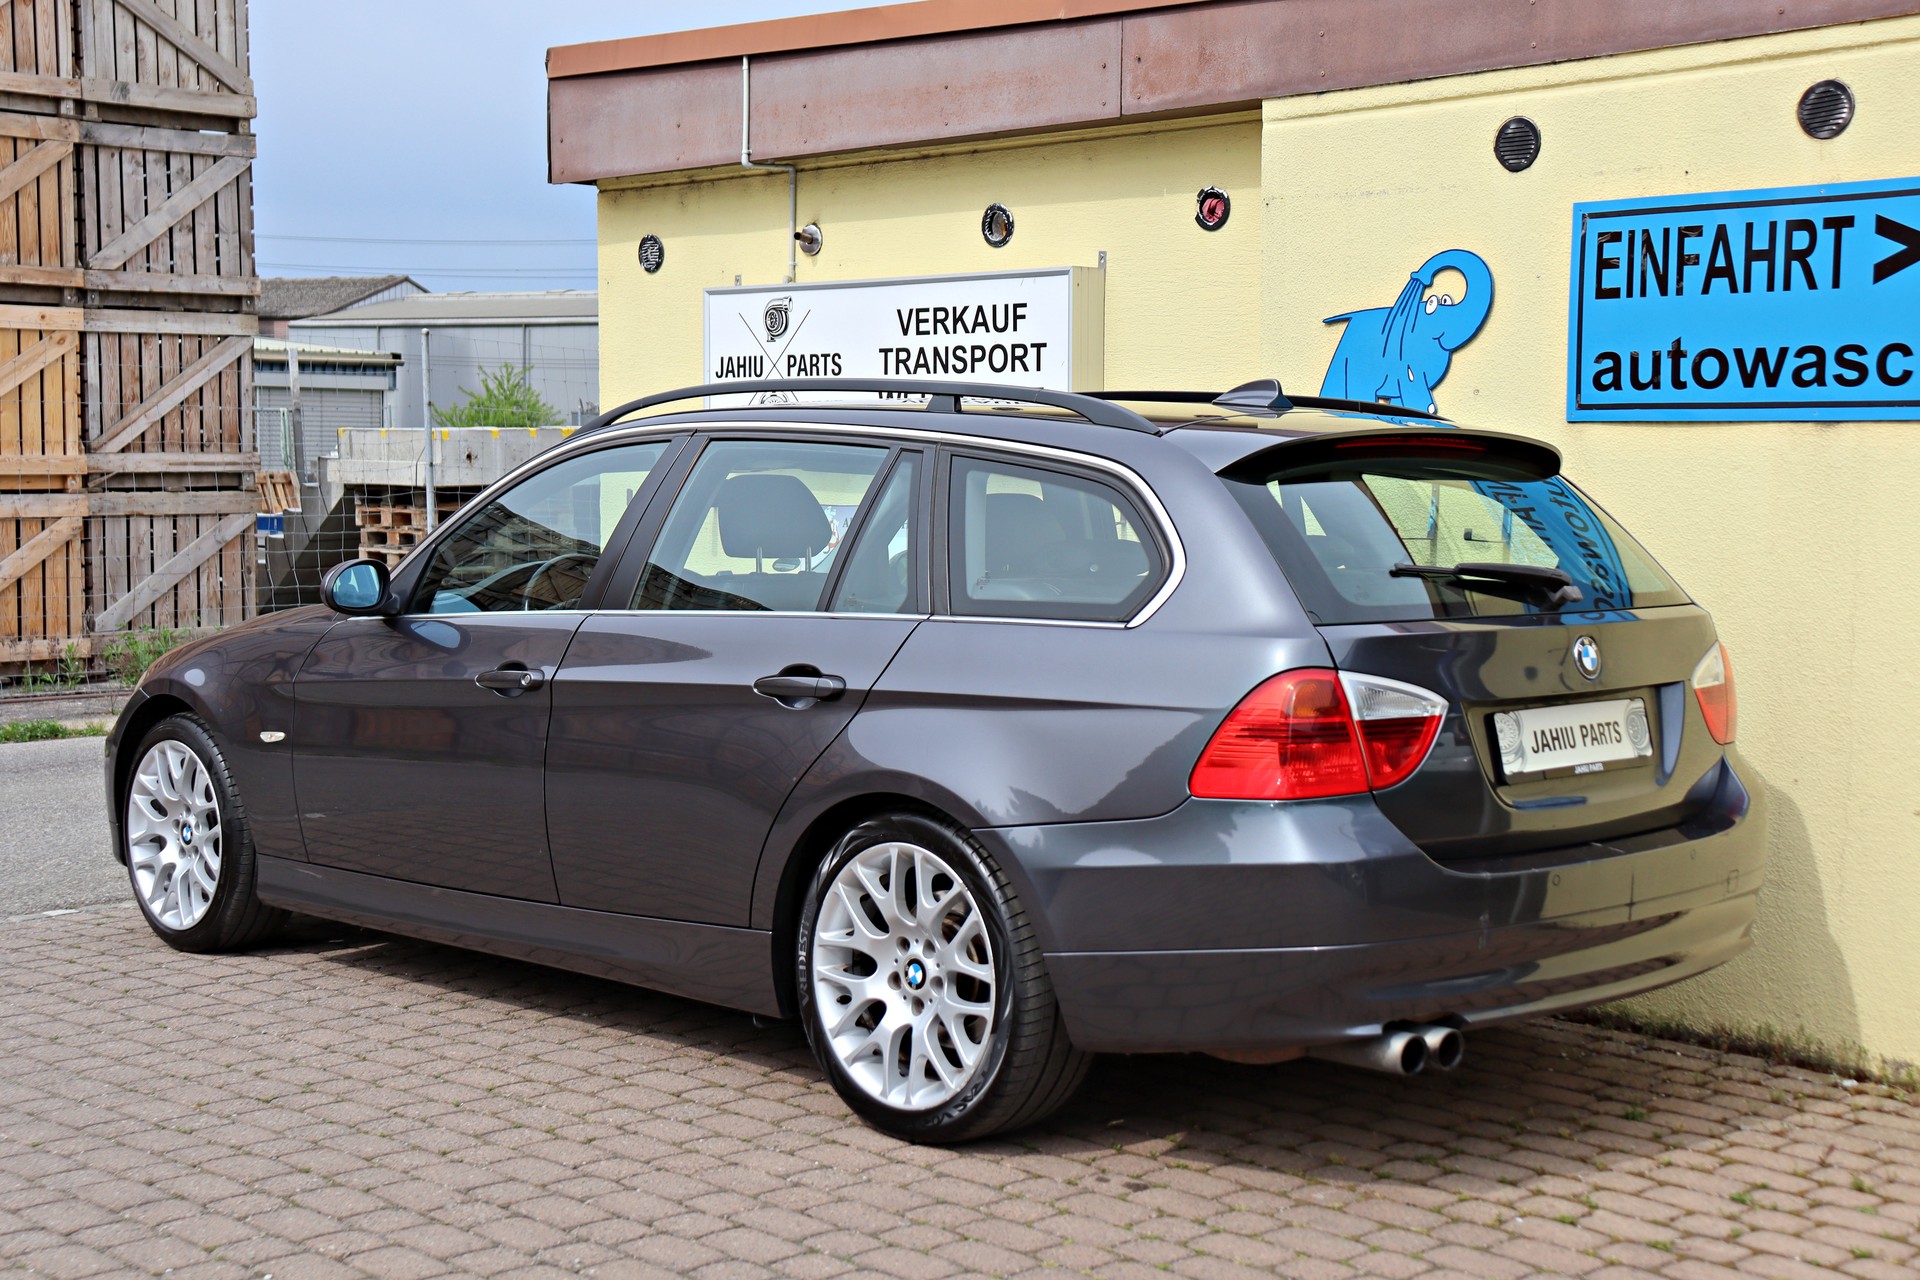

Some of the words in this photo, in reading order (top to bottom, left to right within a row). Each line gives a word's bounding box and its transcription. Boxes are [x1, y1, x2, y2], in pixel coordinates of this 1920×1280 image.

[1595, 215, 1855, 300] EINFAHRT
[896, 302, 1028, 337] VERKAUF
[715, 355, 764, 379] JAHIU
[787, 352, 842, 377] PARTS
[879, 342, 1048, 376] TRANSPORT
[1592, 336, 1914, 392] autowasc
[1531, 726, 1577, 754] JAHIU
[1579, 721, 1623, 748] PARTS
